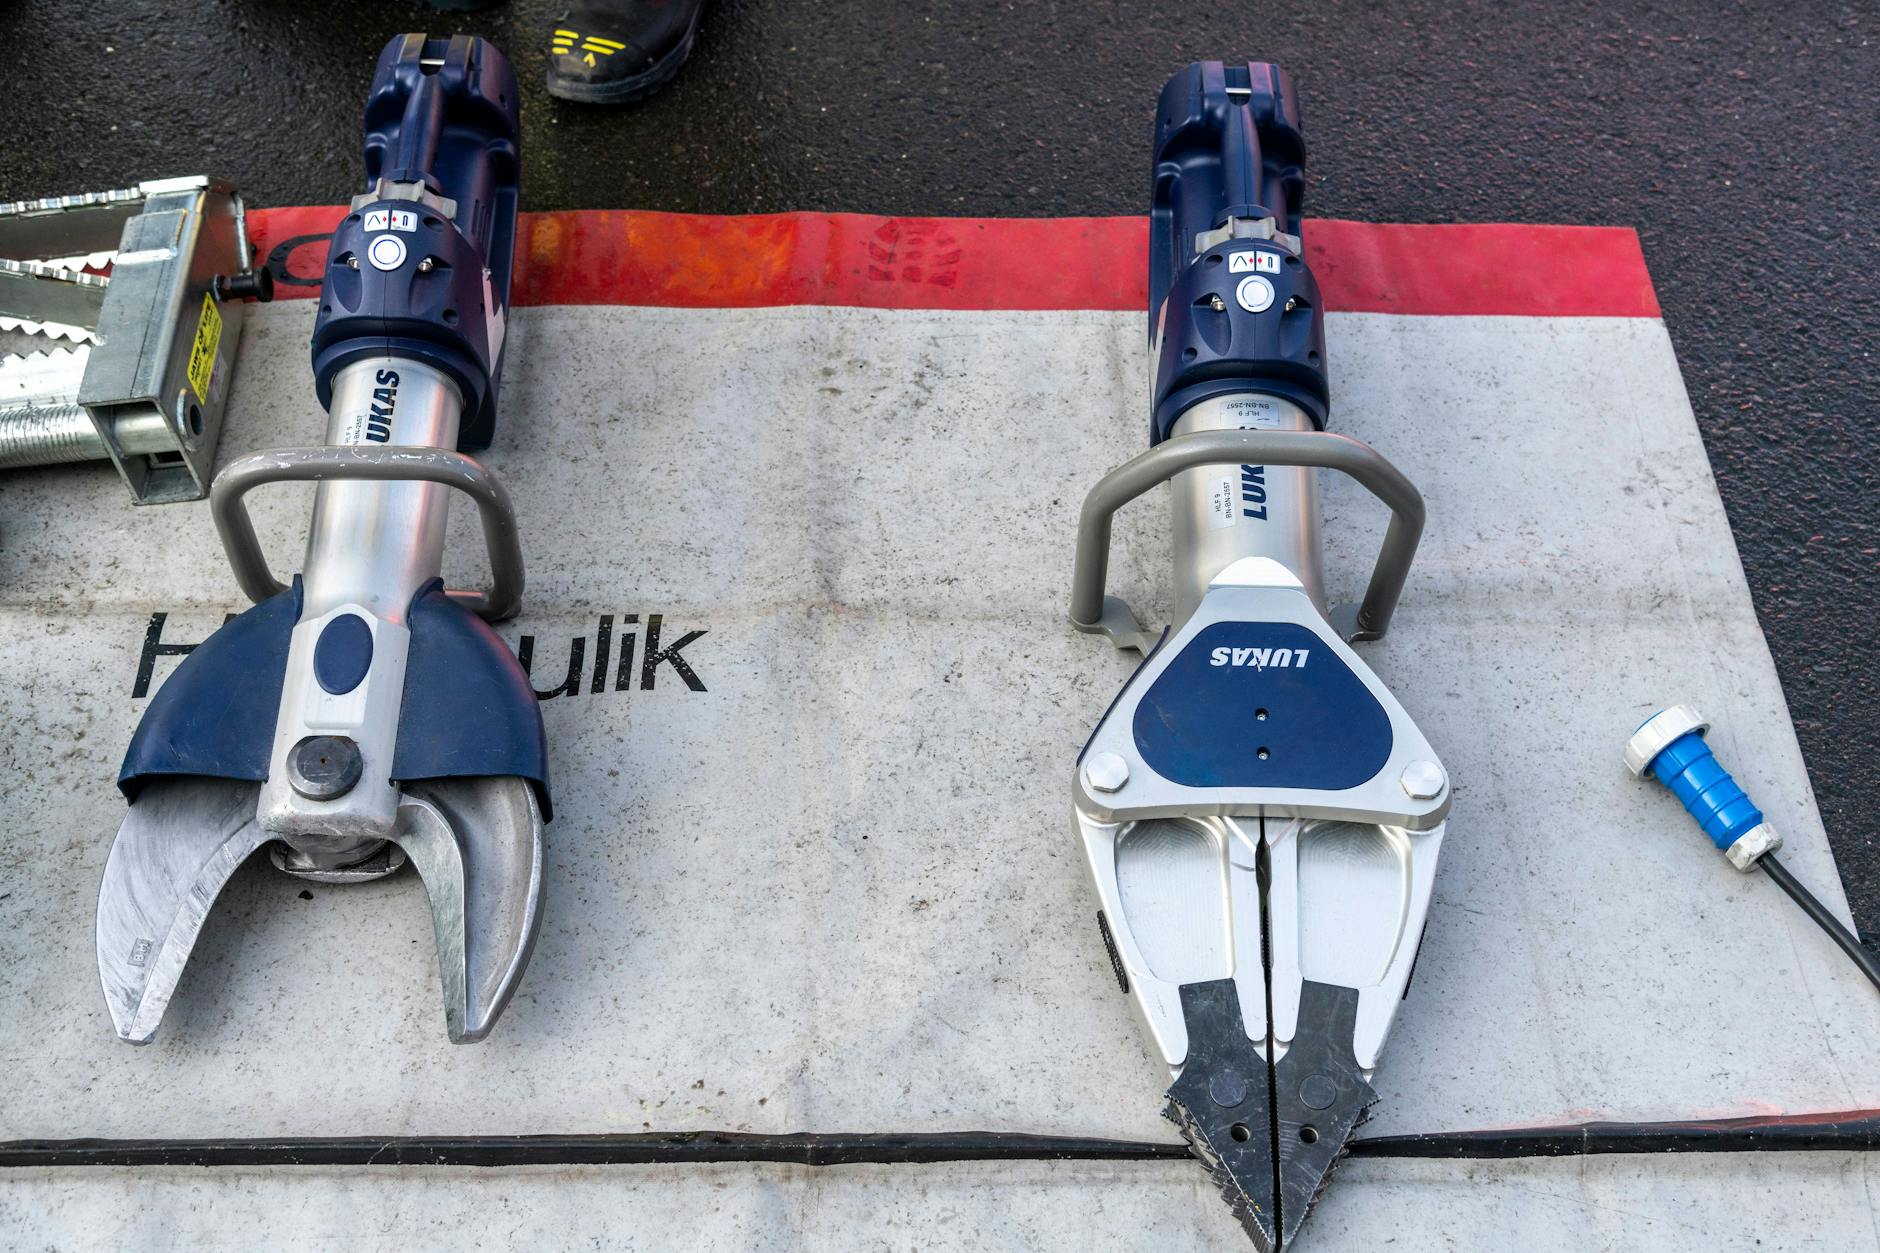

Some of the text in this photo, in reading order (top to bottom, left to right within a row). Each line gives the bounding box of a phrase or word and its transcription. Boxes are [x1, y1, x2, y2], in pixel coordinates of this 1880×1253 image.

[366, 369, 400, 446] UKAS
[1241, 464, 1267, 520] LUK
[1209, 646, 1310, 668] LUKAS
